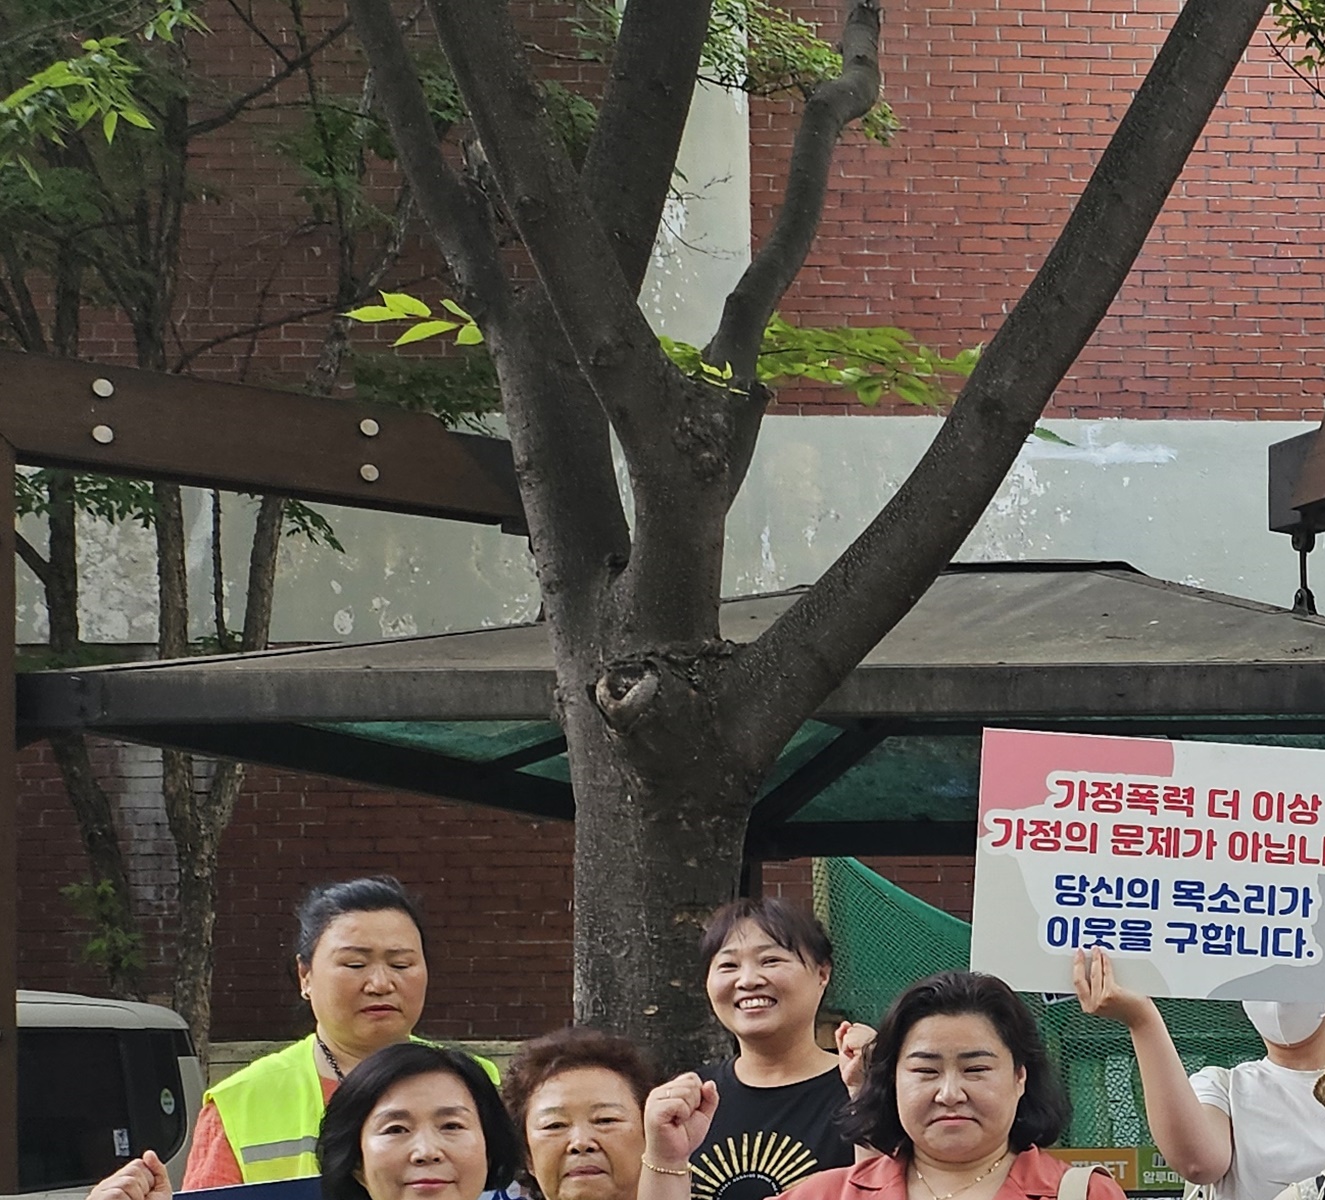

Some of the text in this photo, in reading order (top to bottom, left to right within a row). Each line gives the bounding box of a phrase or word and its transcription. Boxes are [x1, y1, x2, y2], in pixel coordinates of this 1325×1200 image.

[1054, 780, 1322, 825] 가정폭력 더 이상
[991, 818, 1098, 853] 가정의
[1112, 825, 1217, 860] 문제가
[1055, 875, 1313, 918] 당신의 목소리가
[1047, 916, 1315, 959] 이웃을 구합니다.
[1143, 1171, 1185, 1184] 알루미
